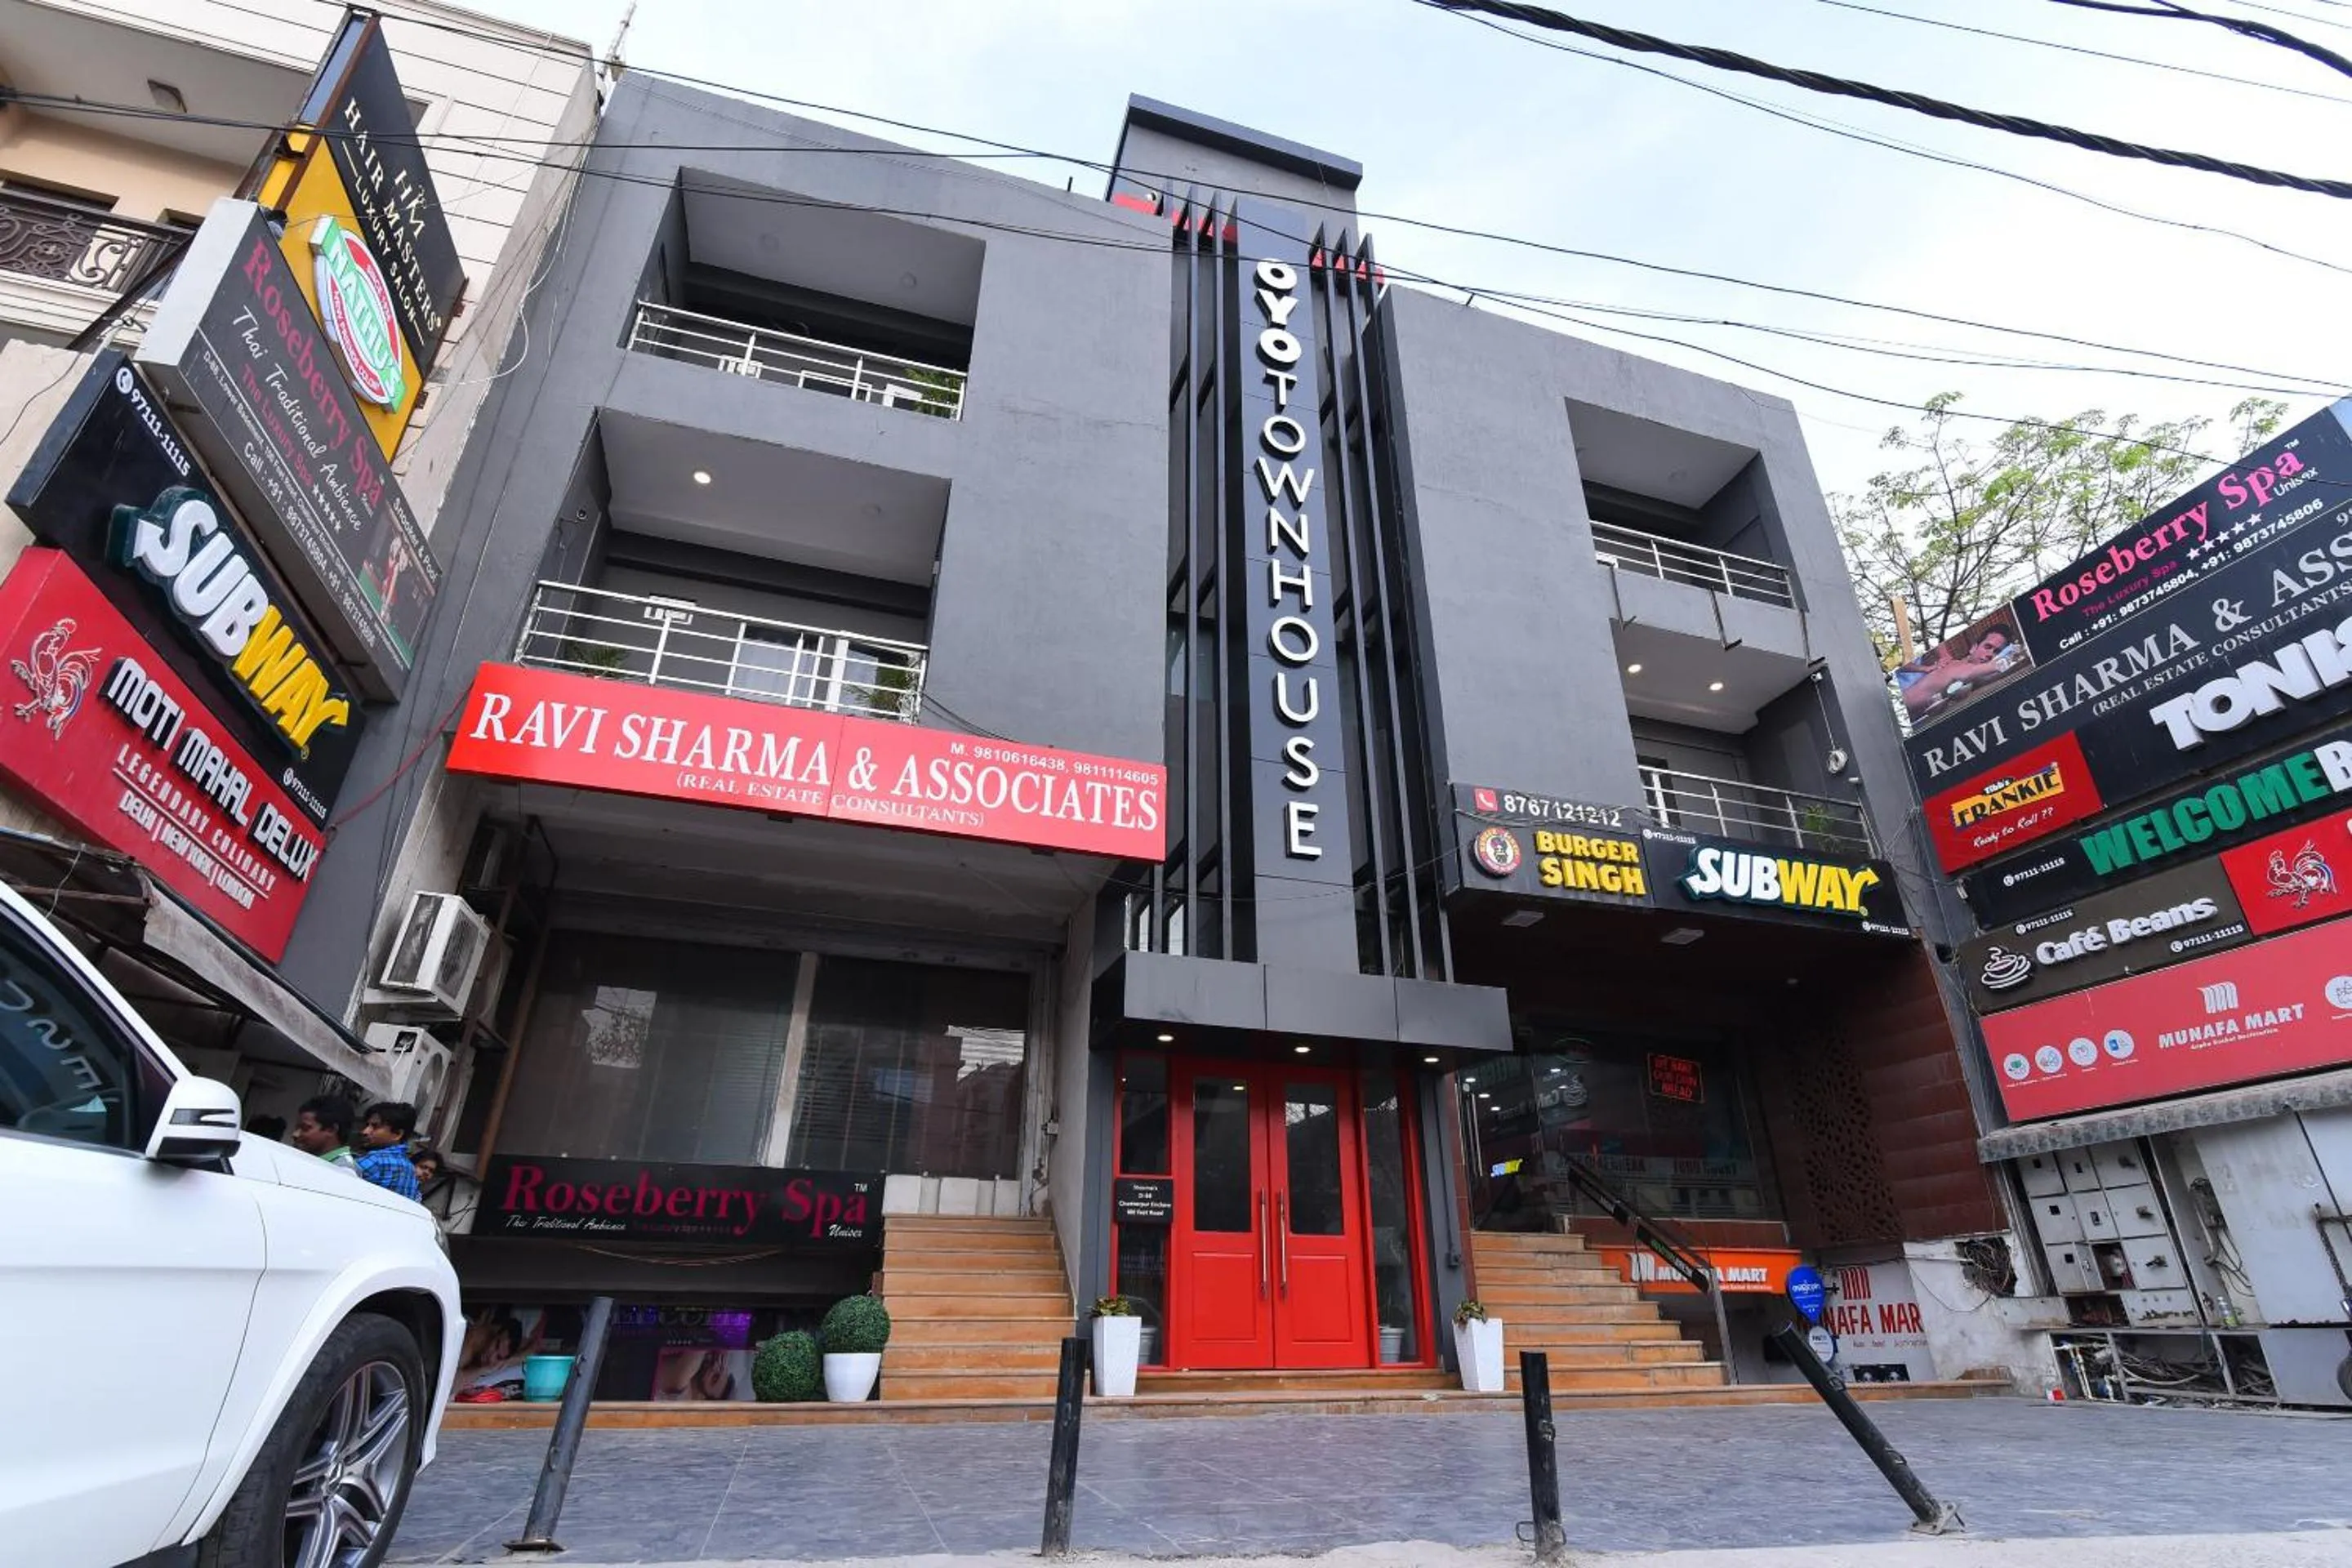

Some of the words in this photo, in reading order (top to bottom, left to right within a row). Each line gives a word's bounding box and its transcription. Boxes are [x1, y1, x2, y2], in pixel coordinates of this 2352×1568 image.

[345, 97, 384, 193] HAIR
[384, 198, 439, 332] MASTERS
[355, 175, 390, 256] LUXURY
[390, 261, 416, 322] SALON
[243, 236, 352, 448] Roseberry
[350, 438, 385, 508] Spa
[131, 388, 191, 477] 97111-11115
[233, 305, 269, 359] Thai
[265, 363, 327, 459] Traditional
[319, 463, 362, 531] Ambience
[244, 442, 264, 474] Call
[2273, 466, 2319, 497] Unisex
[2031, 498, 2209, 623] Roseberry
[2217, 450, 2305, 510] Spa
[2082, 599, 2107, 618] The
[2107, 576, 2150, 606] Luxury
[2153, 559, 2178, 580] Spa
[133, 498, 348, 747] SUBWAY
[2060, 632, 2082, 650] Call
[1923, 715, 2010, 777] RAVI
[2017, 622, 2202, 733] SHARMA
[2212, 597, 2252, 633] &
[2092, 688, 2142, 717] (REAL
[2145, 653, 2210, 691] ESTATE
[108, 657, 186, 751] MOTI
[177, 728, 253, 826] MAHAL
[253, 801, 319, 883] DELUX
[470, 692, 608, 754] RAVI
[614, 712, 831, 786] SHARMA
[847, 746, 879, 792] &
[890, 754, 1158, 831] ASSOCIATES
[116, 743, 211, 834] LEGENDARY
[211, 828, 276, 892] CULINARY
[676, 771, 740, 796] (REAL
[746, 783, 825, 807] ESTATE
[831, 792, 985, 827] CONSULTANTS)
[1957, 770, 2060, 826] FRANKIE
[1535, 830, 1640, 864] BURGER
[1973, 831, 2000, 849] Ready
[2002, 825, 2015, 836] to
[1539, 857, 1646, 896] SINGH
[1686, 847, 1880, 912] SUBWAY
[2036, 926, 2109, 965] Café
[2107, 898, 2219, 944] Beans
[2158, 1018, 2240, 1049] MUNAFA
[2244, 1003, 2305, 1031] MART
[499, 1162, 765, 1236] Roseberry
[782, 1178, 867, 1240] Spa
[854, 1183, 868, 1192] TM
[1727, 1267, 1768, 1282] MART
